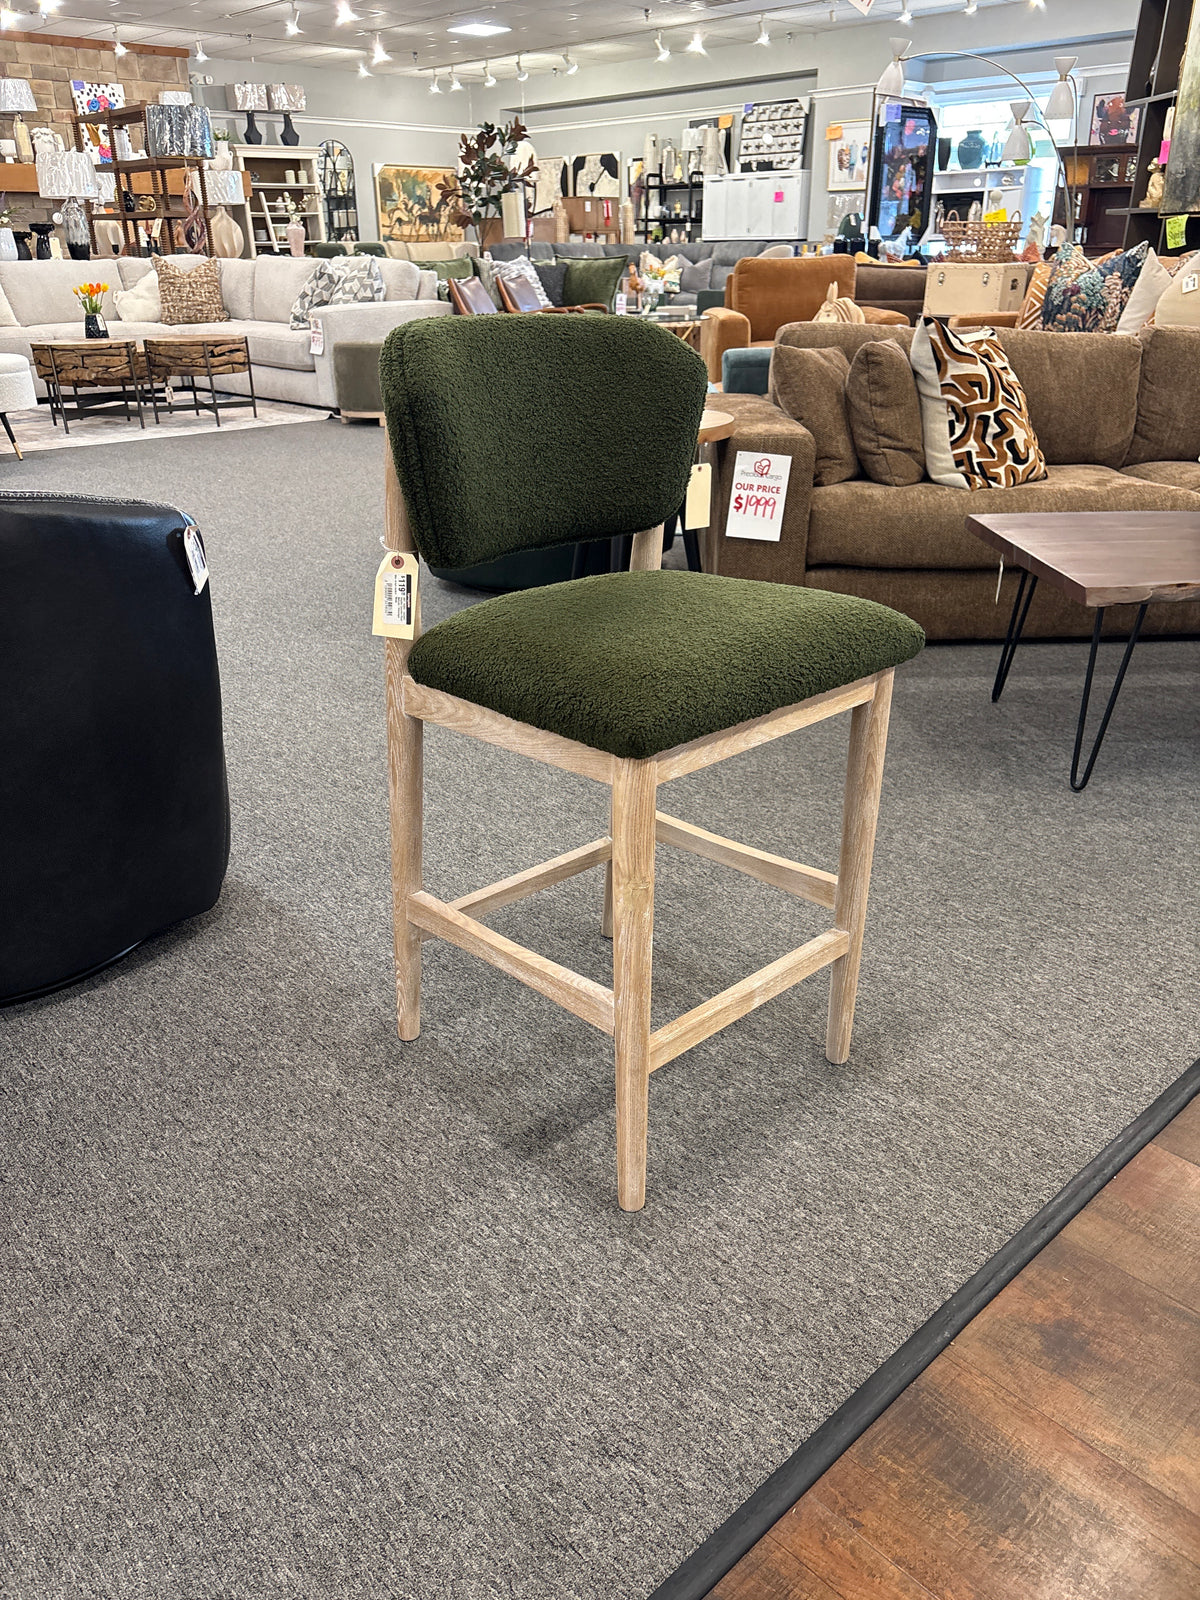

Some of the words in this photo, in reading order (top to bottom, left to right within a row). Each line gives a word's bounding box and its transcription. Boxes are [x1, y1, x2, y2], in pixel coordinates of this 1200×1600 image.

[735, 482, 754, 491] OUR
[757, 485, 781, 494] PRICE
[733, 493, 776, 519] $1999
